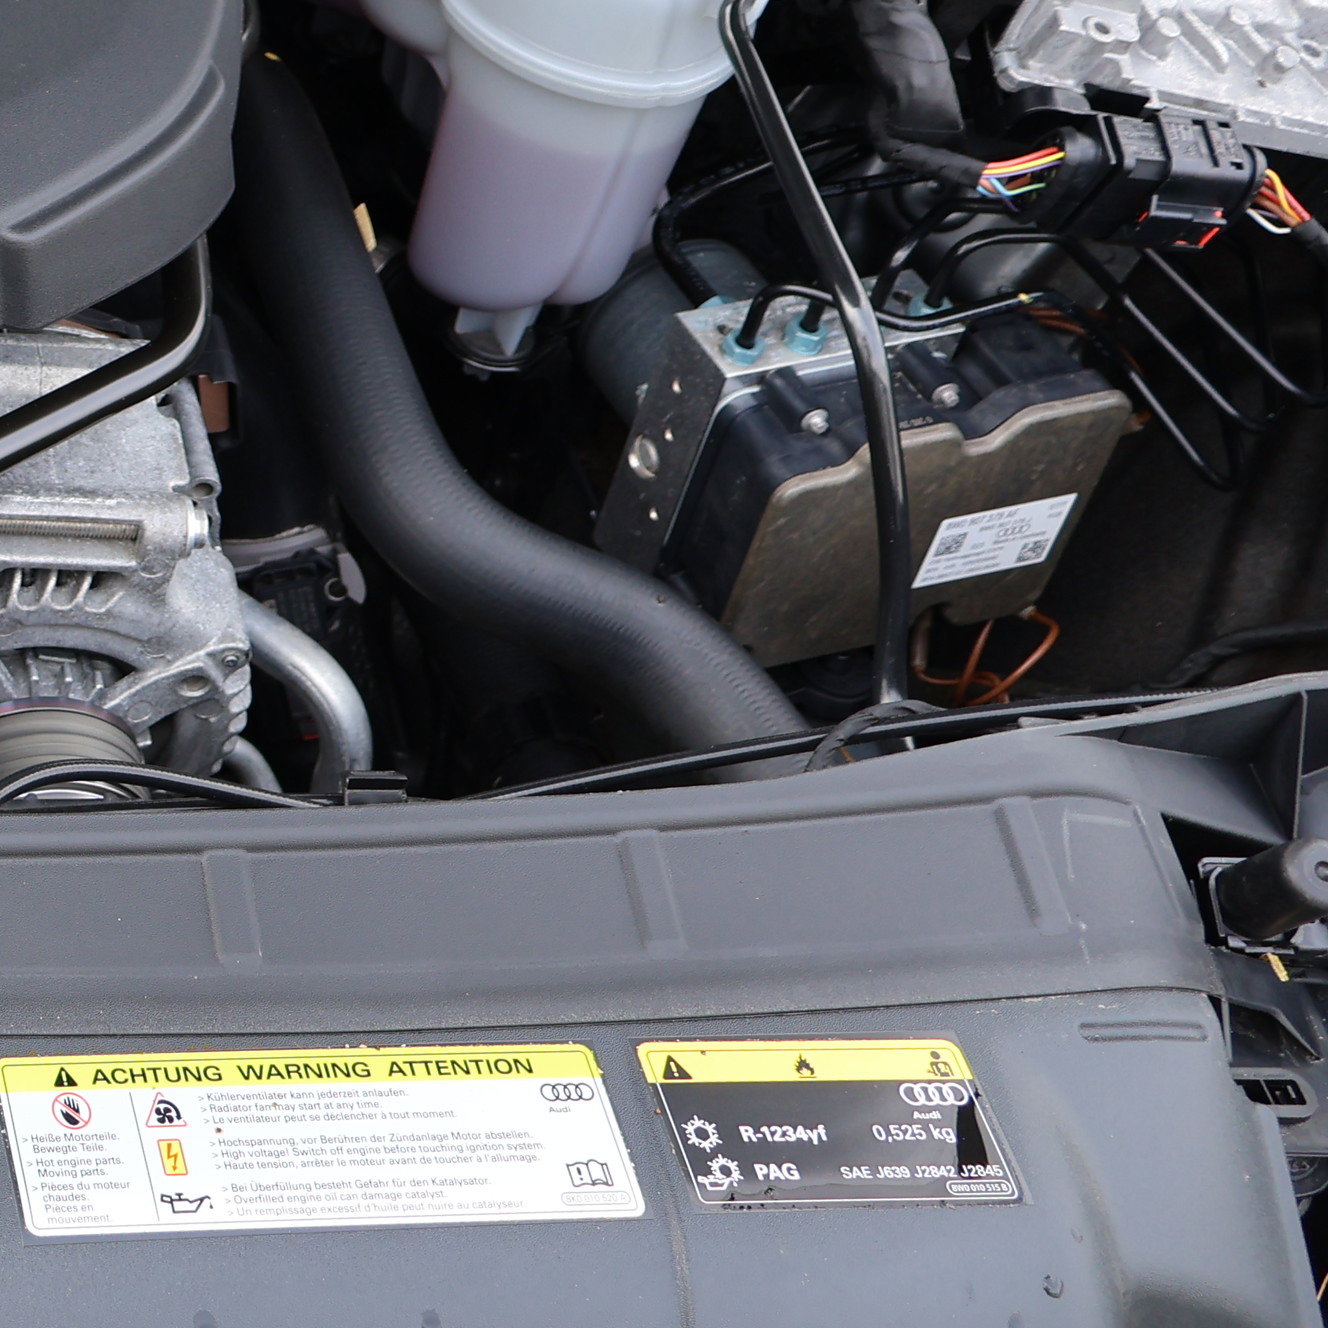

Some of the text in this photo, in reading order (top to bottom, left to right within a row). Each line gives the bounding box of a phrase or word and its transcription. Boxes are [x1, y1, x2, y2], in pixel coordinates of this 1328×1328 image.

[91, 1057, 534, 1085] ACHTUNG WARNING ATTENTION
[206, 1088, 409, 1102] Kühlerventilator kann jederzeit anlaufen.
[209, 1099, 382, 1112] Radiator fan may start at any time.
[212, 1109, 457, 1124] Le ventilateur peut se déclencher à tout moment.
[913, 1111, 941, 1121] Audi
[31, 1133, 120, 1143] Heiße Motorteile.
[218, 1130, 533, 1147] Hochspannung, vor Berühren der Zündanlage Motor abstellen.
[739, 1124, 956, 1144] R-1234yf 0,525 kg
[33, 1143, 107, 1154] Bewegte Teile.
[221, 1149, 245, 1160] High
[248, 1148, 289, 1158] voltage!
[292, 1147, 327, 1156] Switch
[330, 1146, 343, 1155] off
[347, 1146, 381, 1156] engine
[383, 1144, 417, 1154] before
[418, 1143, 464, 1153] touching
[466, 1142, 505, 1152] ignition
[36, 1157, 124, 1168] Hot engine parts.
[224, 1153, 540, 1170] Haute tension, arrêter le moteur avant de toucher à l'allumage.
[38, 1167, 108, 1178] Moving parts.
[754, 1163, 1003, 1180] PAG SAE J639 J2842 J2845
[41, 1181, 130, 1192] Pièces du moteur
[231, 1177, 491, 1192] Bei Überfüllung besteht Gefahr für den Katalysator.
[950, 1184, 970, 1192] 8W0
[971, 1184, 986, 1192] 010
[986, 1184, 1001, 1192] 515
[42, 1193, 89, 1202] chaudes.
[234, 1190, 447, 1204] Overfilled engine oil can damage catalyst.
[45, 1203, 94, 1213] Pièces en
[237, 1207, 252, 1216] Un
[255, 1205, 317, 1216] remplissage
[320, 1203, 361, 1213] excessif
[364, 1202, 399, 1212] d'huile
[402, 1202, 424, 1212] peut
[427, 1201, 454, 1210] nuire
[457, 1202, 469, 1210] au
